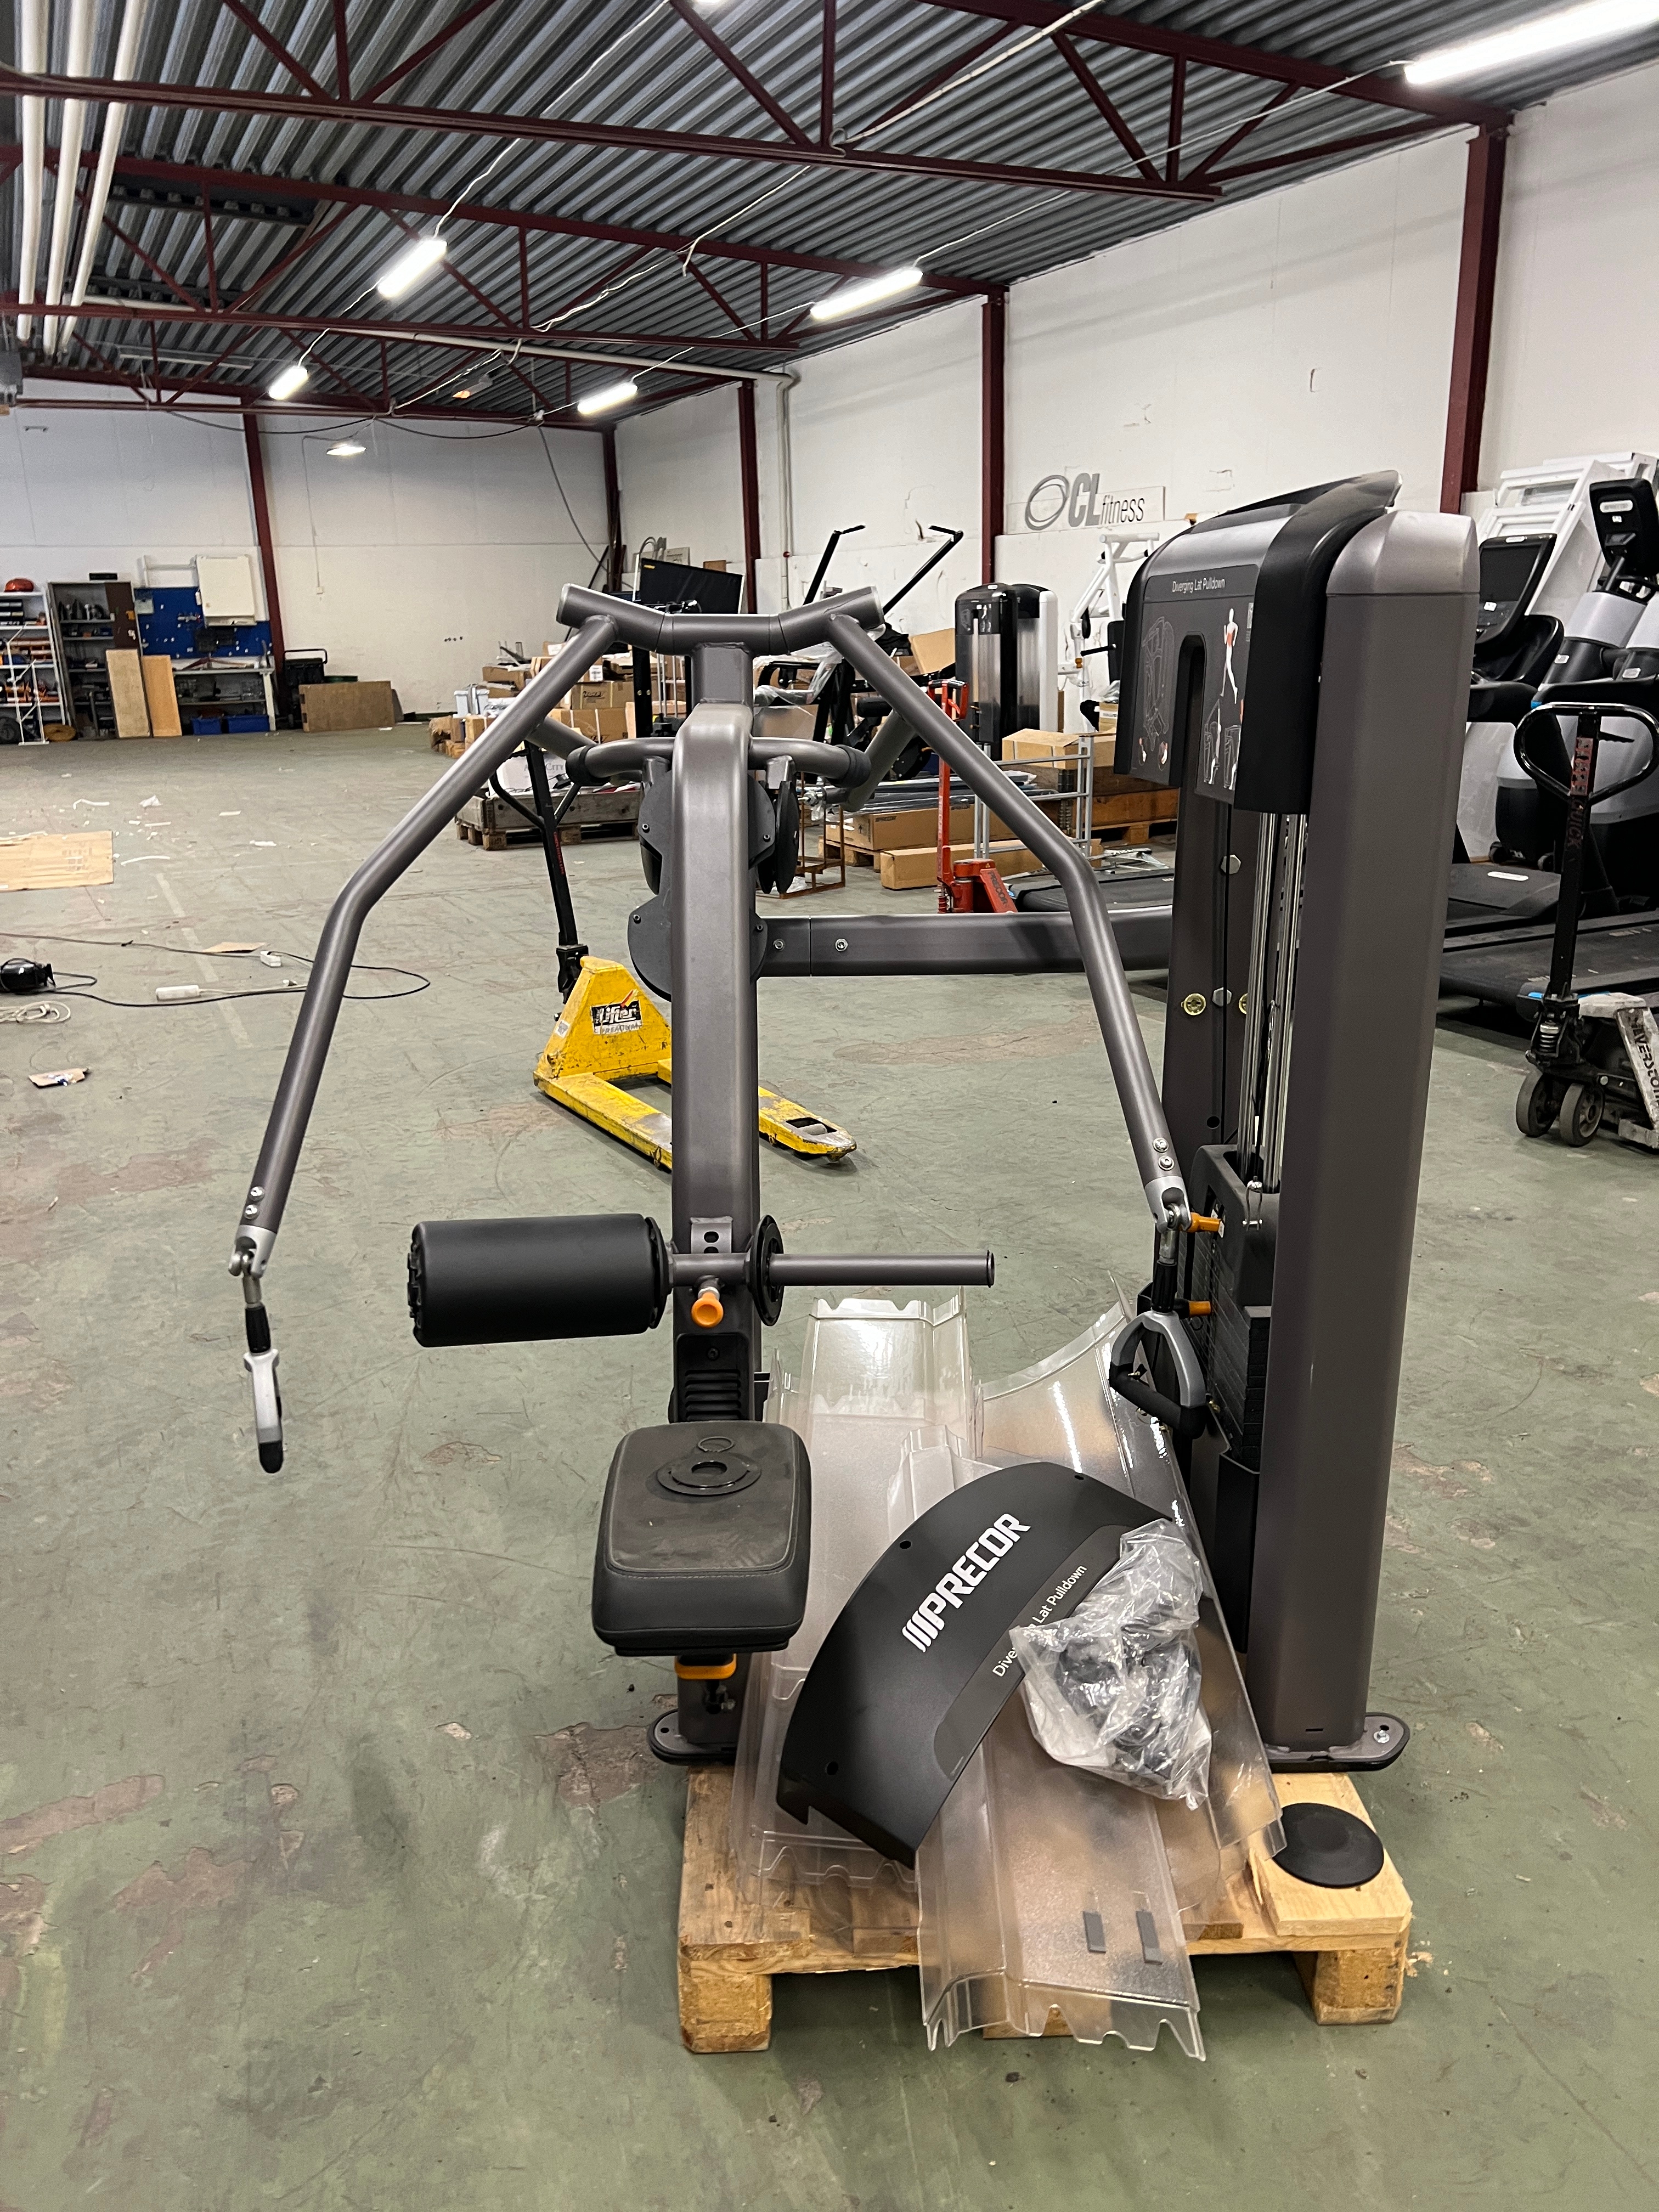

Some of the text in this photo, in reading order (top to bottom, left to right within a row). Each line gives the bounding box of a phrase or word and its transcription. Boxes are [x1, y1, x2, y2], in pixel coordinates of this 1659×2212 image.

[1101, 494, 1145, 525] fitness
[1172, 579, 1194, 594] Diverging
[1203, 576, 1226, 590] Pulldown
[902, 1513, 1031, 1652] PRECOR
[1032, 1605, 1053, 1623] Lat
[1046, 1565, 1088, 1606] Pulldown
